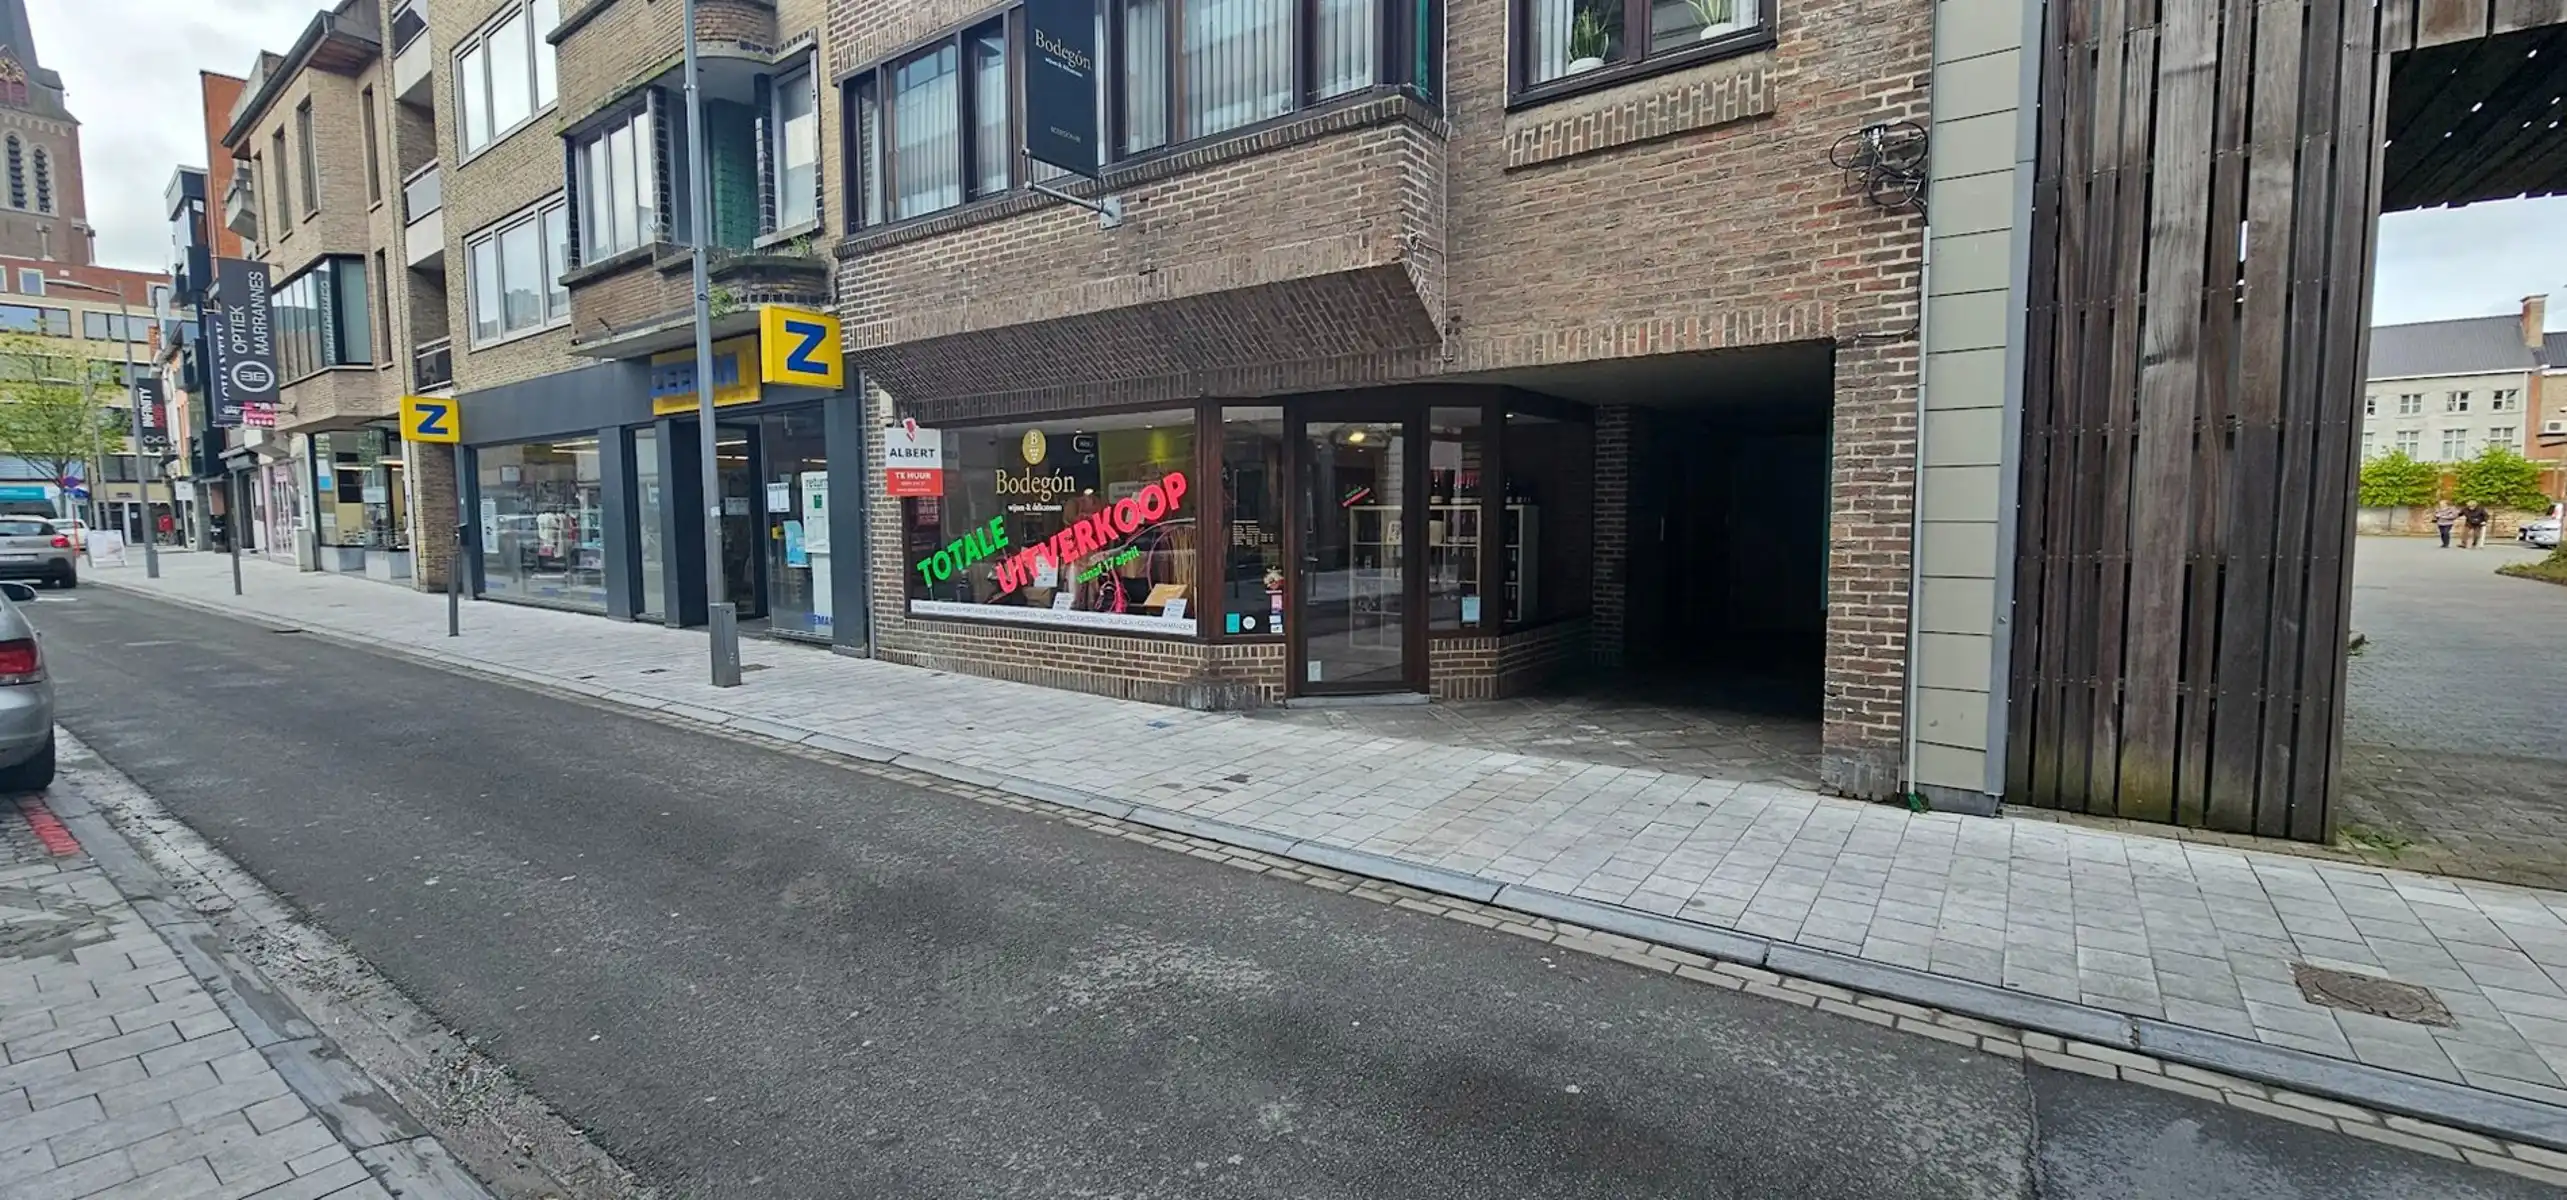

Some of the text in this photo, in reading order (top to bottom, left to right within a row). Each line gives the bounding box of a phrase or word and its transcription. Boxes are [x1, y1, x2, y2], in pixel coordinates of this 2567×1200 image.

[1035, 28, 1092, 70] Bodegón
[229, 305, 248, 354] OPTIEK
[248, 271, 269, 356] MARRANNES
[785, 320, 829, 375] Z
[139, 387, 155, 428] INFINITY
[415, 403, 448, 435] Z
[889, 448, 936, 458] ALBERT
[895, 472, 931, 480] TE HUUR
[995, 467, 1076, 502] Bodegón
[917, 515, 1009, 588] TOTALE
[995, 472, 1188, 595] UITVERKOOP
[1077, 545, 1140, 584] vanaf 17 april
